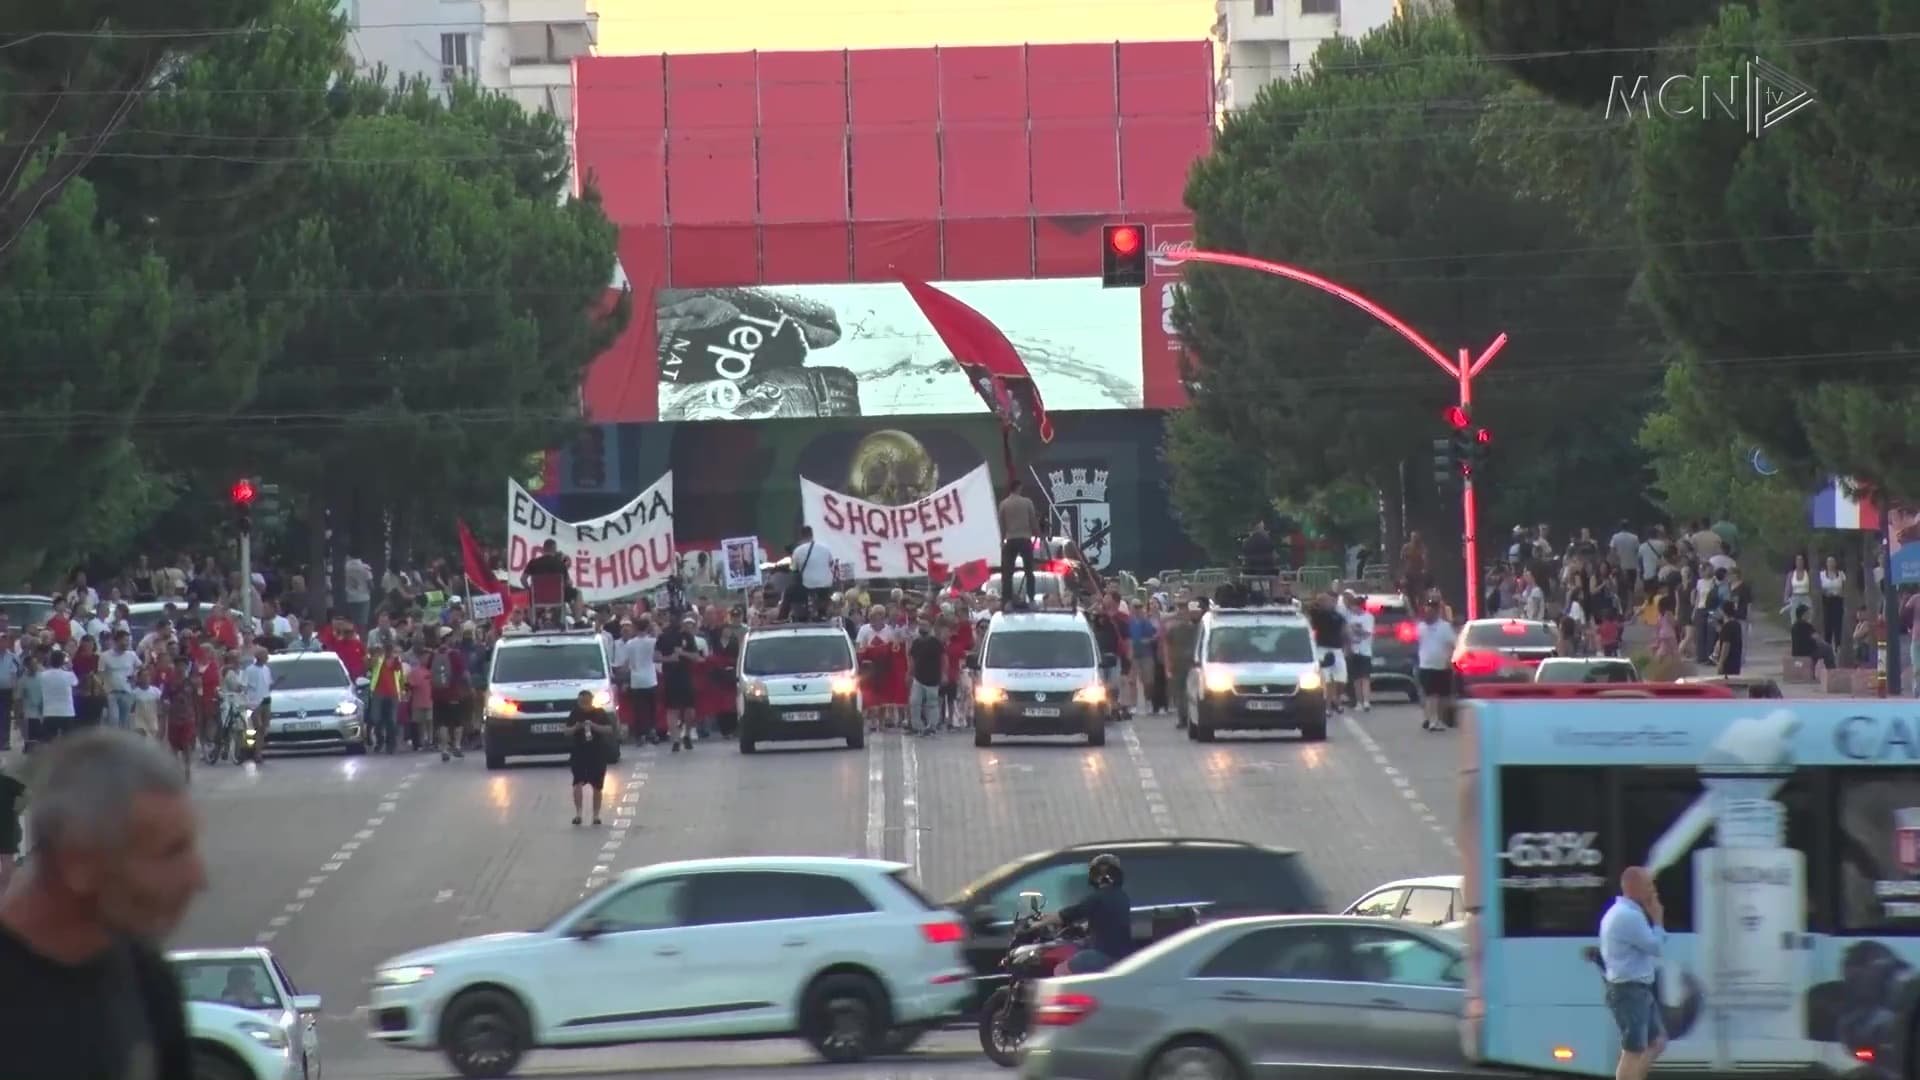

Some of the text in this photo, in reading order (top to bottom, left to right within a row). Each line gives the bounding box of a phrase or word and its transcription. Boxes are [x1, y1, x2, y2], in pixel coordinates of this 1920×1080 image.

[512, 489, 674, 542] EDI RAMA
[823, 488, 964, 540] SHQIPËRI
[509, 532, 673, 588] DËHIQU
[861, 537, 944, 574] E RE
[1832, 715, 1920, 760] CA
